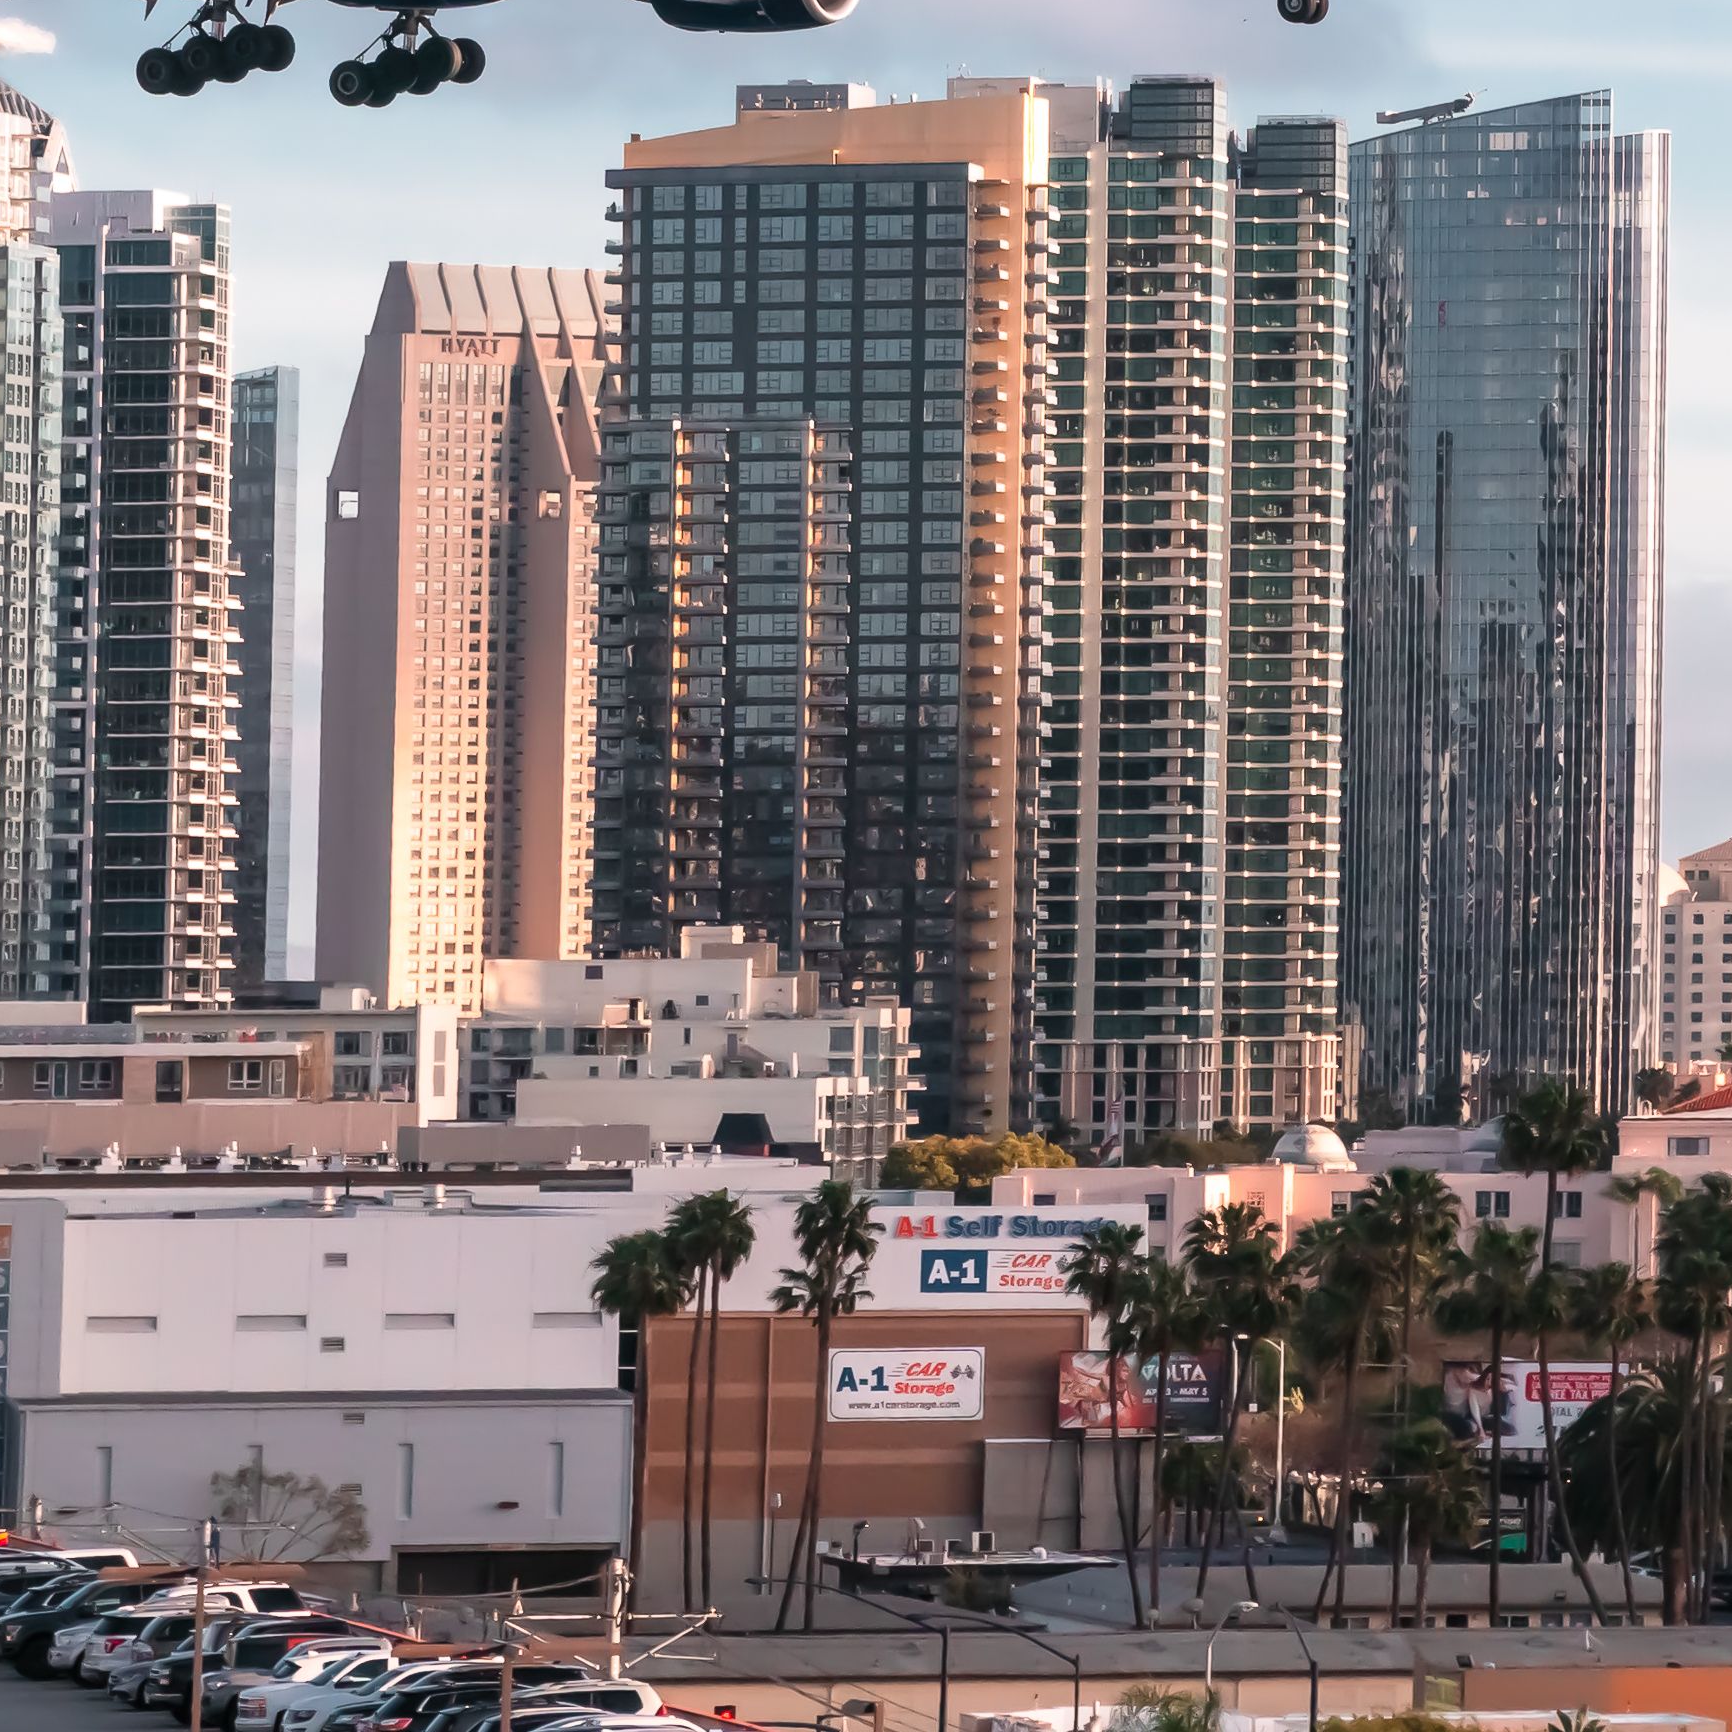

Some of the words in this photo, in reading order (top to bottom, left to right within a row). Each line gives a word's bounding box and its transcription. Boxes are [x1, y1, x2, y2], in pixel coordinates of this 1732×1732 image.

[441, 338, 500, 355] HYATT
[896, 1215, 939, 1239] A-1
[945, 1214, 1003, 1239] Self
[1011, 1253, 1052, 1269] CAR
[927, 1258, 980, 1285] A-1
[998, 1274, 1064, 1290] Storage
[906, 1362, 947, 1377] CAR
[836, 1366, 889, 1393] A-1
[894, 1382, 955, 1396] Storage
[1179, 1388, 1200, 1396] MAY
